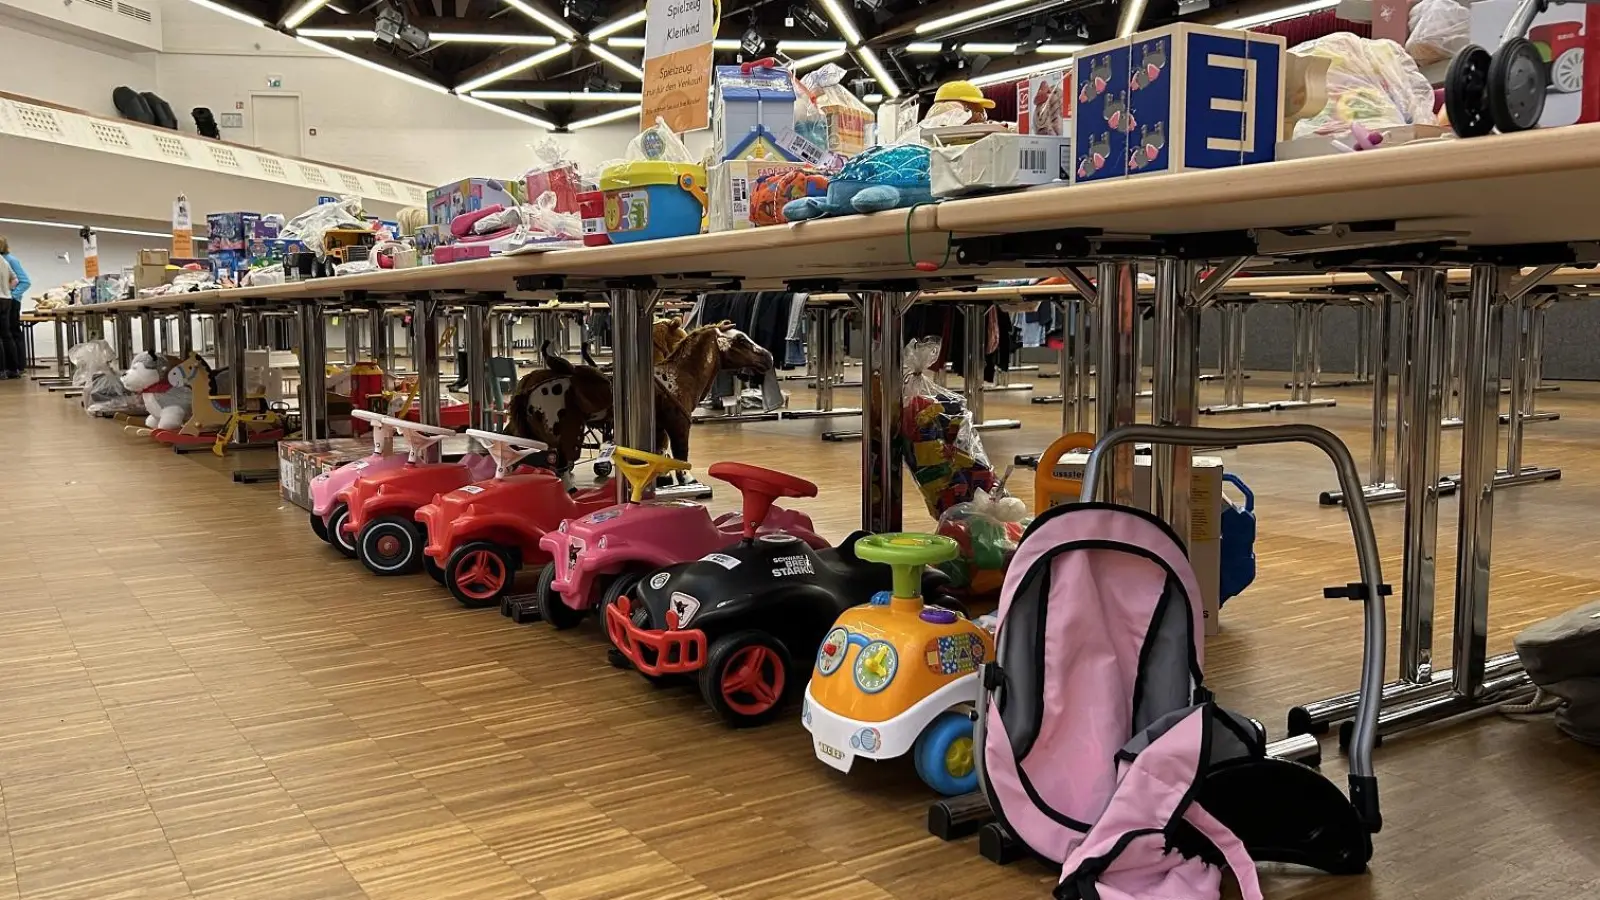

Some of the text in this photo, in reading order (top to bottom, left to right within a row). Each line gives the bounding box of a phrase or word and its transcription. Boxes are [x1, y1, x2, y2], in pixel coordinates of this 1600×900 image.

[667, 0, 701, 19] Spielzeug
[666, 20, 700, 41] Kleinkind
[659, 64, 692, 79] Spielzeug
[665, 82, 677, 92] den
[772, 554, 805, 563] SCHWARZ
